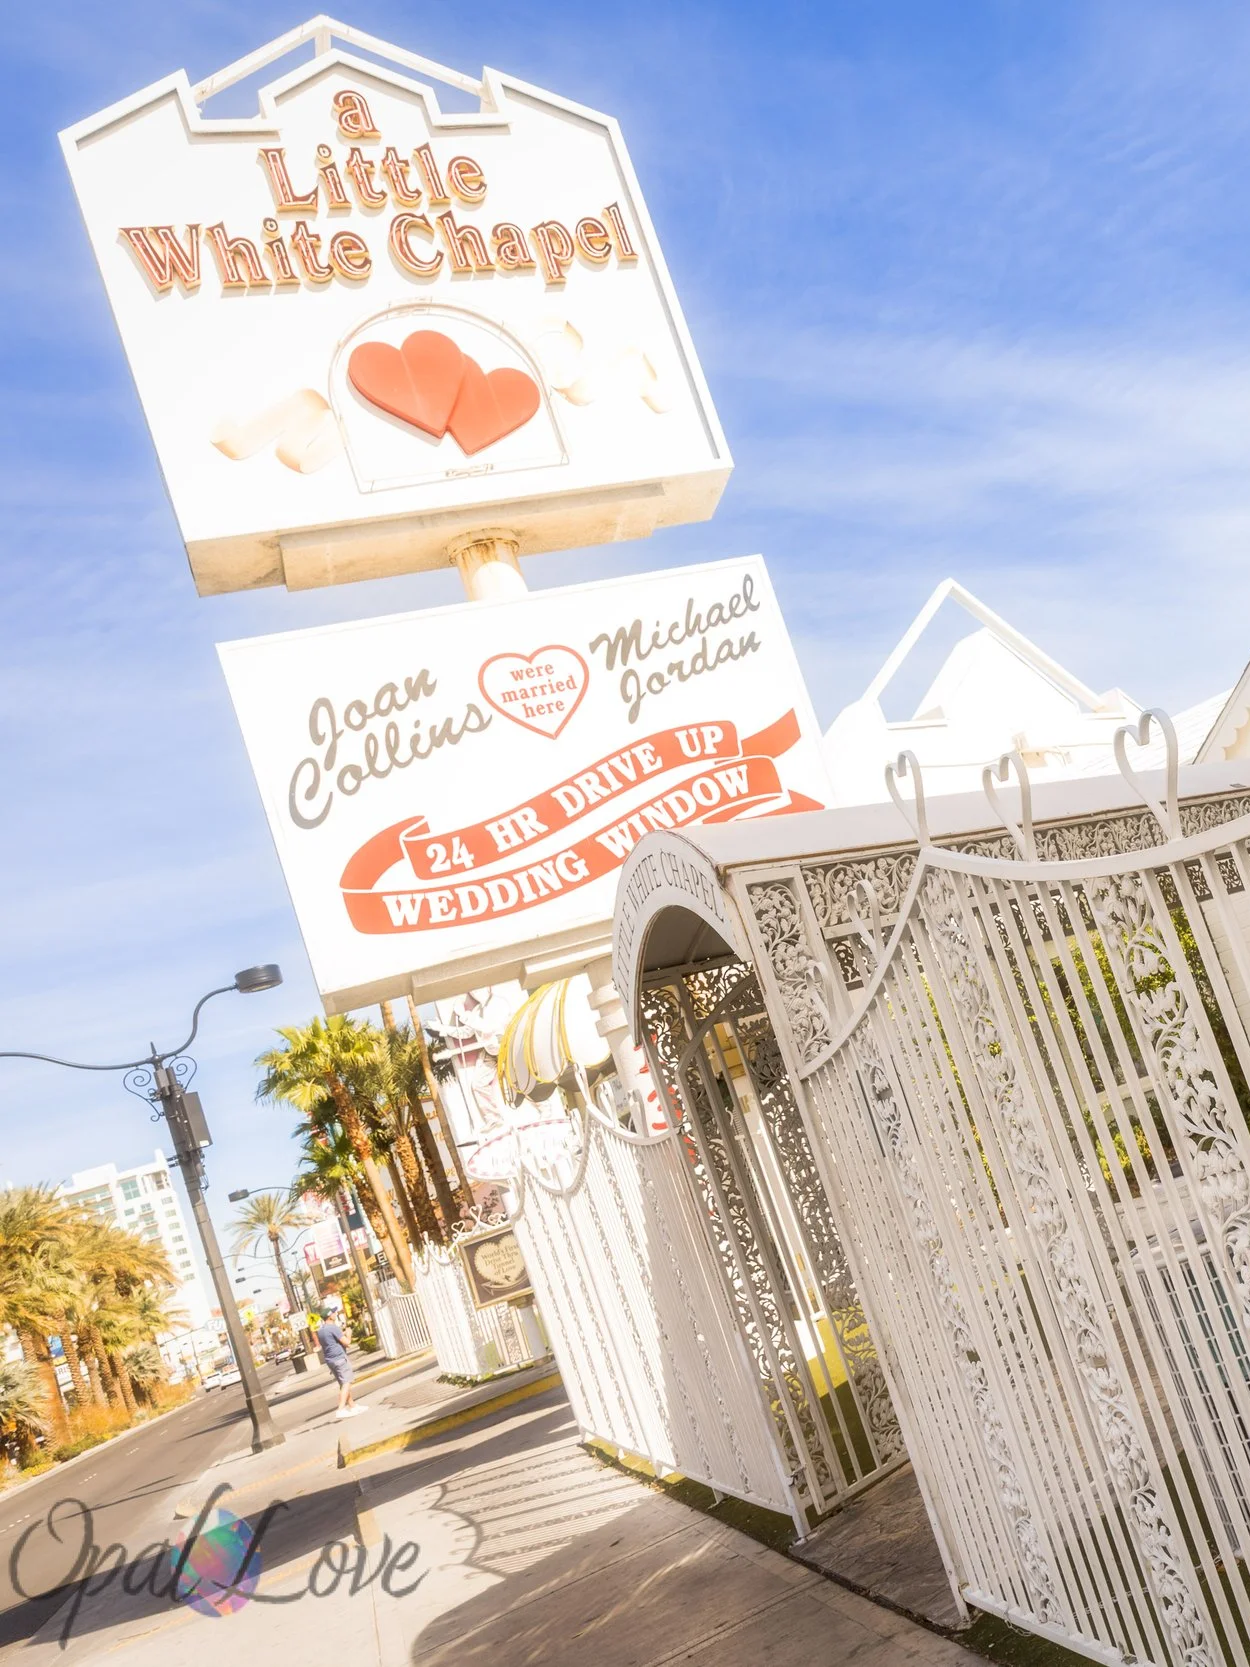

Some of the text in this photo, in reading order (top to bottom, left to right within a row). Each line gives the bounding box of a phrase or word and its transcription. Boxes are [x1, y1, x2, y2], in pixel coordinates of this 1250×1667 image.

[333, 89, 381, 139] a
[257, 141, 489, 212] Little
[118, 201, 638, 292] White Chapel
[589, 573, 761, 671] Michael
[501, 676, 578, 705] married
[510, 662, 555, 683] were
[522, 698, 566, 719] here
[619, 630, 762, 724] Jordan
[308, 668, 438, 771] Joan
[288, 703, 492, 830] Collins
[425, 723, 726, 873] 24 HR DRIVE UP
[382, 764, 751, 928] WEDDING WINDOW
[626, 854, 663, 912] WHITE
[660, 847, 725, 923] CHAPEL
